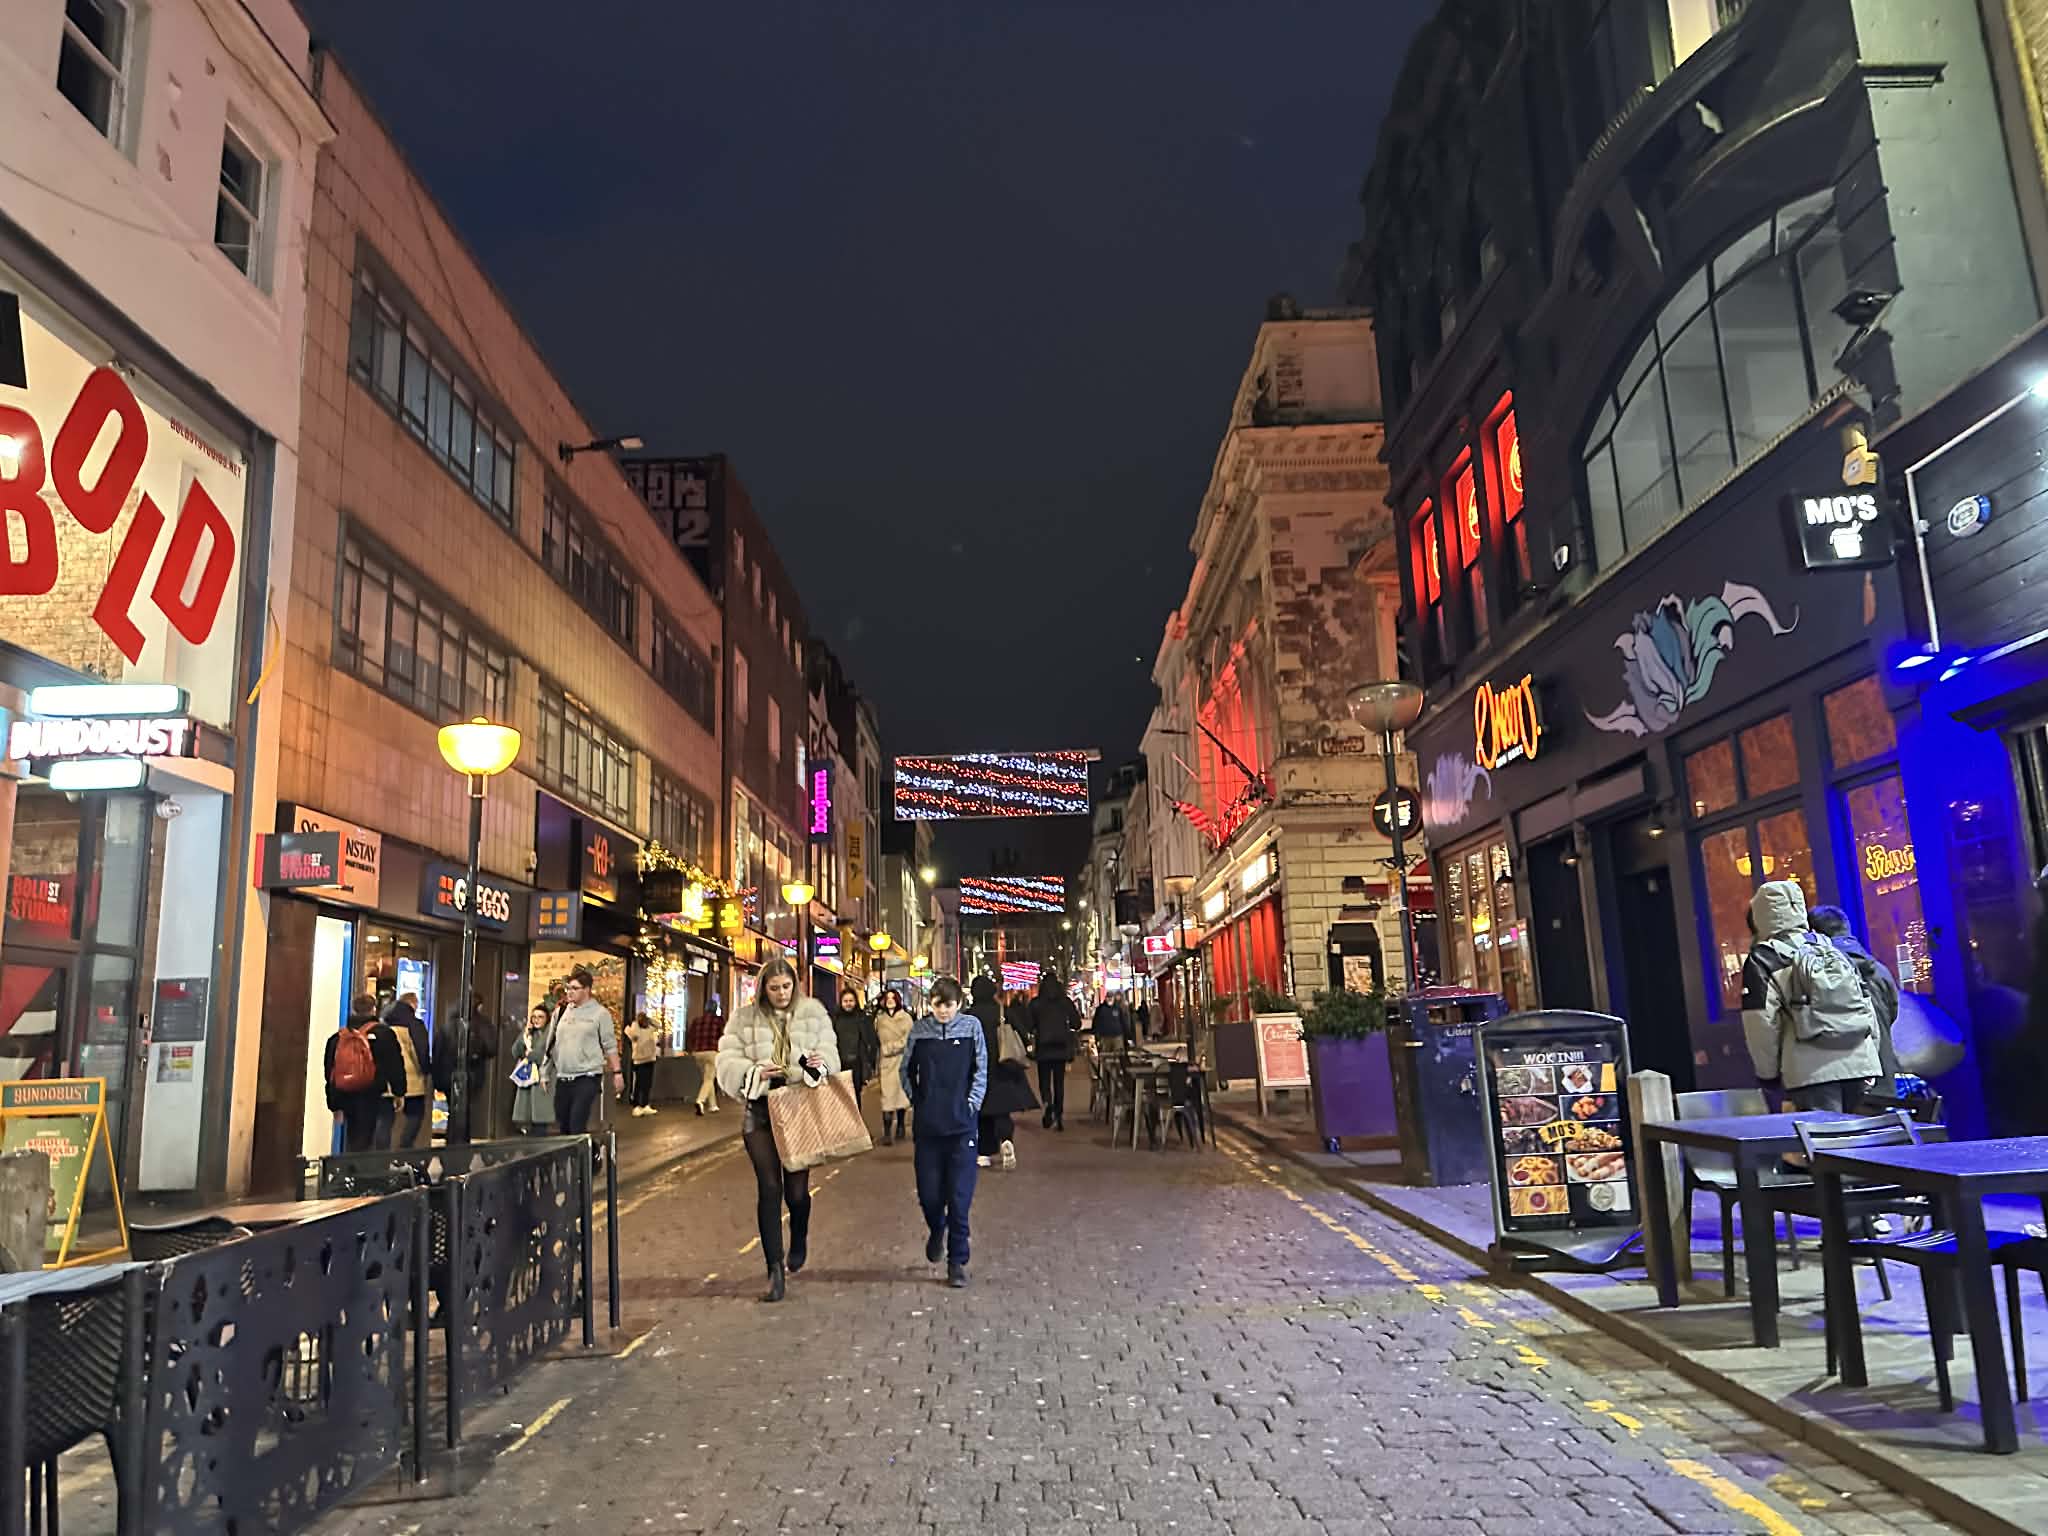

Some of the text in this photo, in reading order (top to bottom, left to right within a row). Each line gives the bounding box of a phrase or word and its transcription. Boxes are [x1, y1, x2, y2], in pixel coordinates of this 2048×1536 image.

[0, 366, 236, 665] BOLD
[1803, 494, 1878, 524] MO'S
[10, 718, 188, 760] BUNDOBUST
[281, 864, 331, 879] STUDIOS
[13, 876, 60, 899] BOLD ST
[454, 878, 510, 922] GEGGS
[14, 1085, 90, 1105] BUNDOBUST
[1546, 1121, 1577, 1140] MO'S
